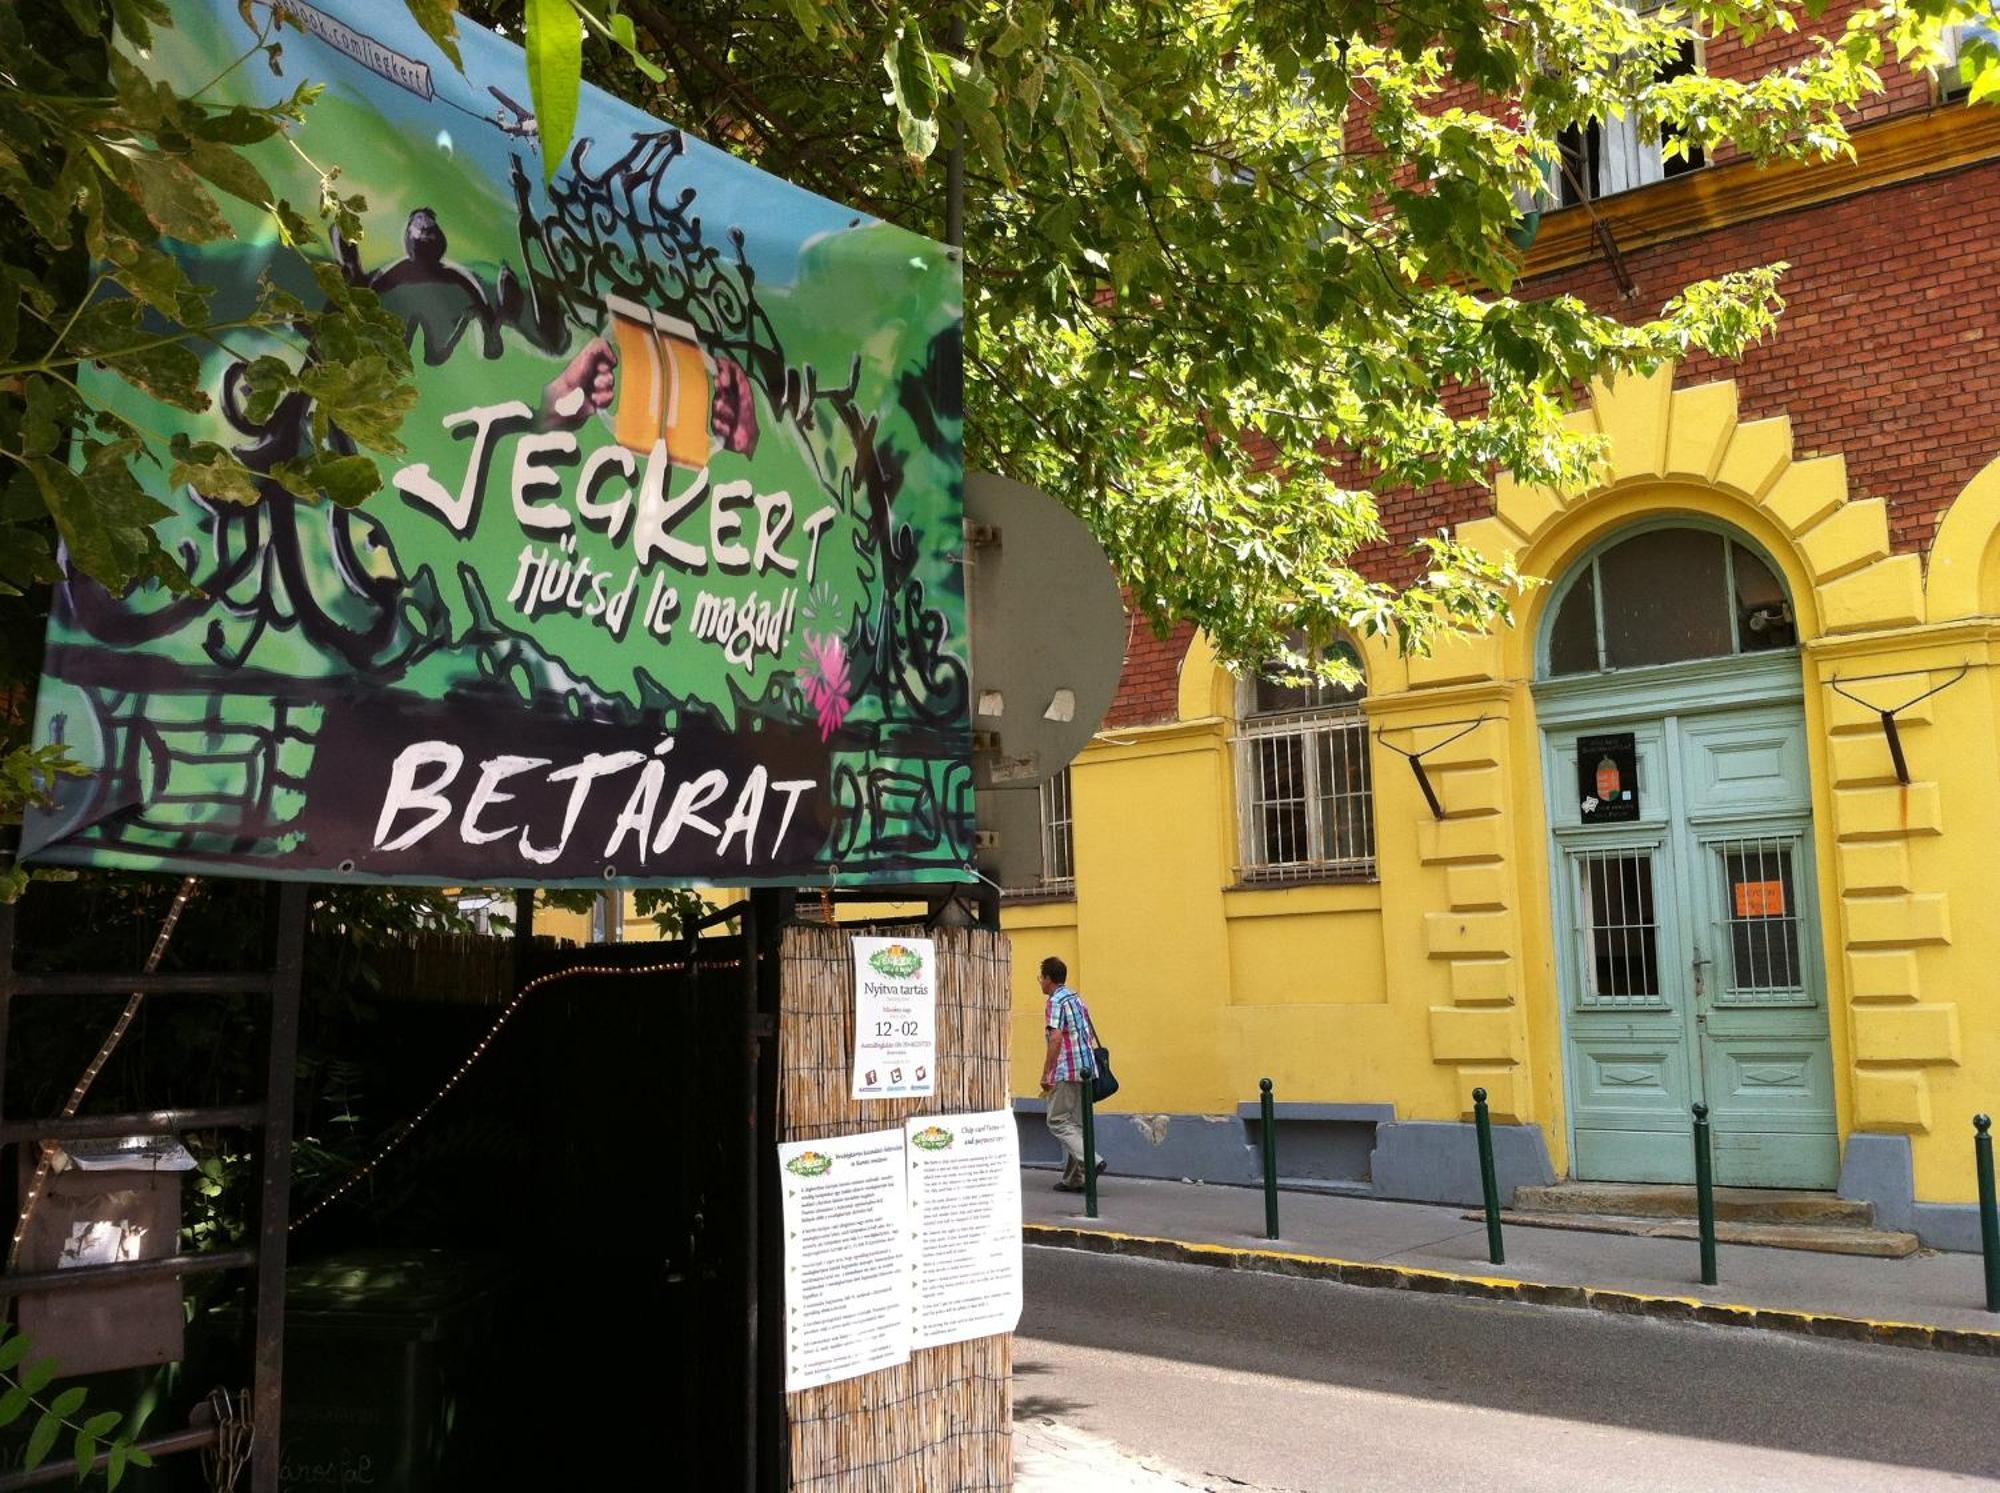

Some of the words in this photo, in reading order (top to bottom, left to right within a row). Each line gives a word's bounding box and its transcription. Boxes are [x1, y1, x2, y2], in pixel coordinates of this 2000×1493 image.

[643, 569, 678, 634] le
[689, 587, 799, 673] magad!
[373, 735, 818, 865] BEJÁRAT
[864, 982, 898, 998] Nyitva
[900, 984, 929, 996] tartás
